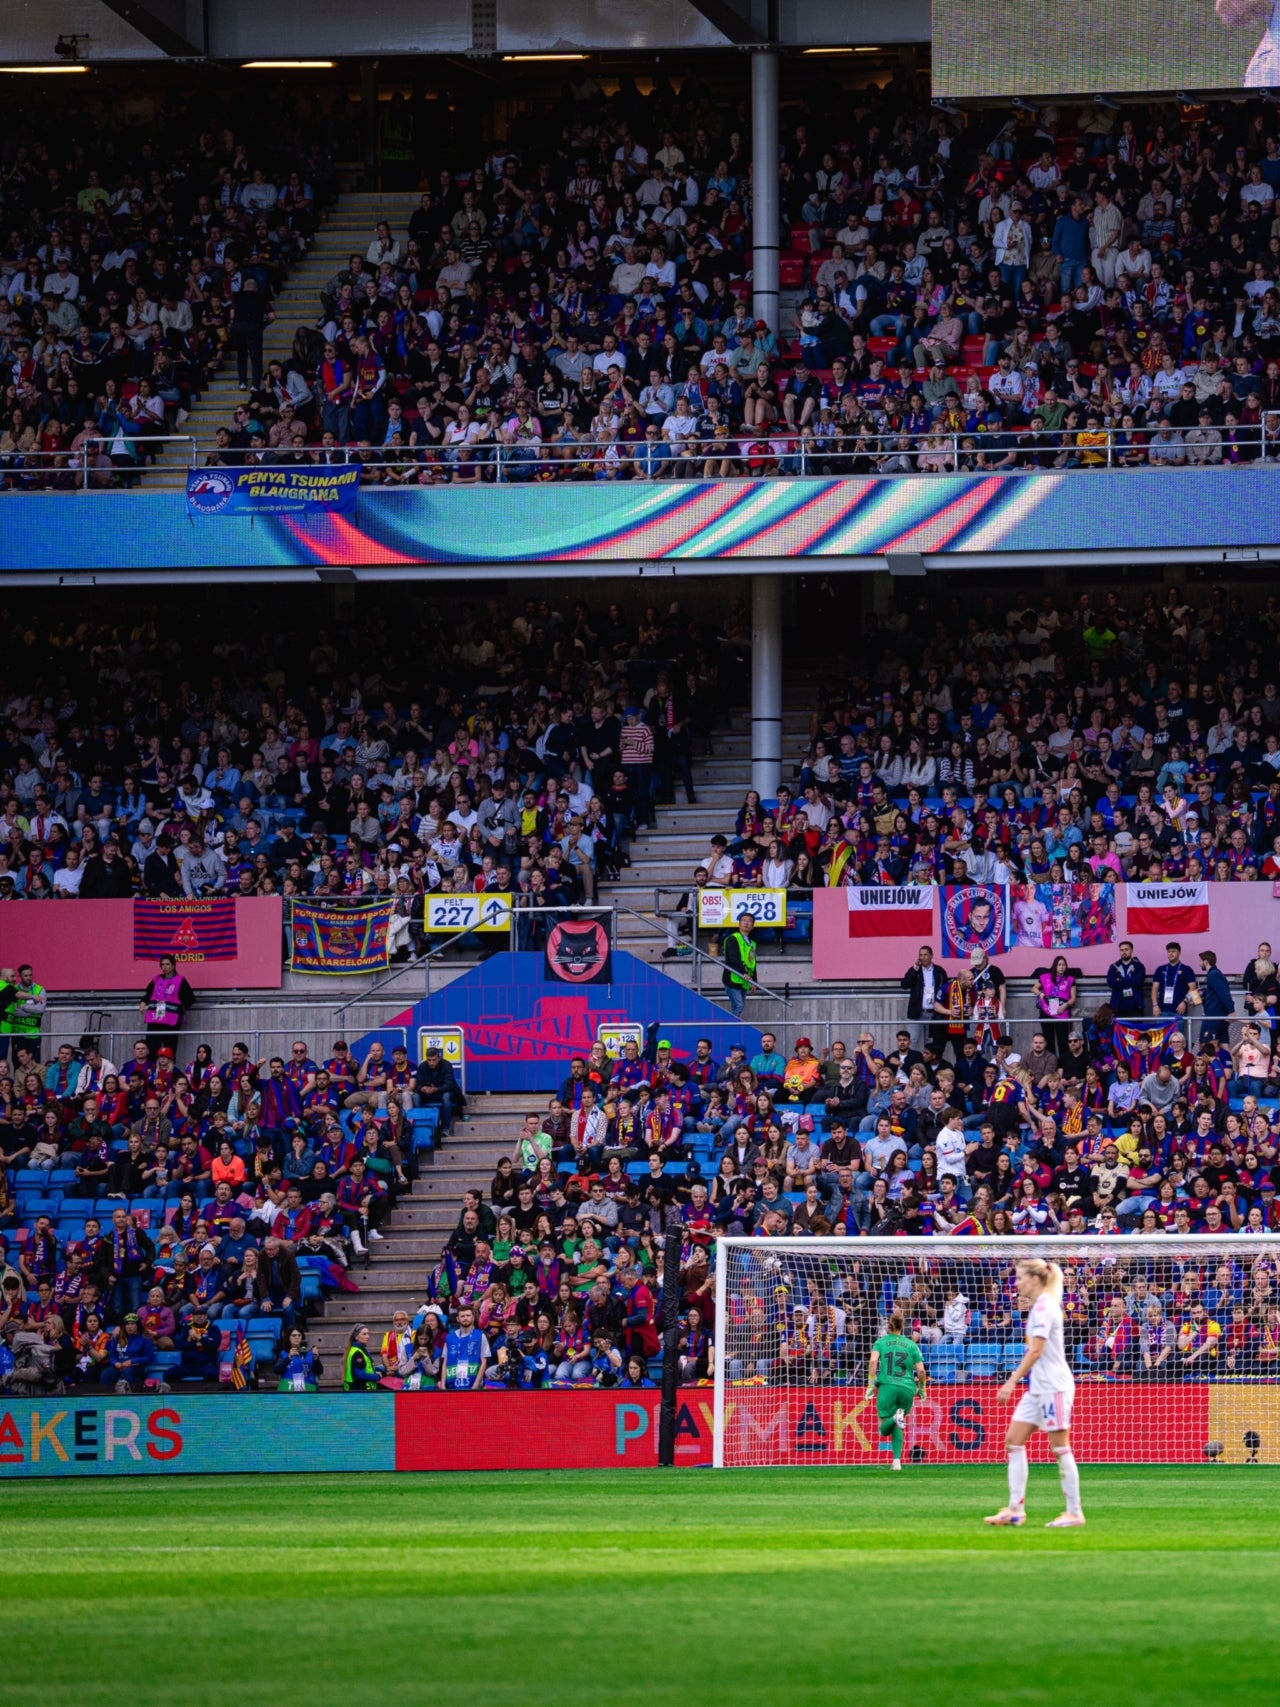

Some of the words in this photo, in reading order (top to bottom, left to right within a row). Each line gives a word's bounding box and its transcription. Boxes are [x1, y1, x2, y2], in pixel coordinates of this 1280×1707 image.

[237, 471, 287, 487] PENYA
[290, 470, 358, 487] TSUNAMI
[249, 486, 340, 502] BLAUGRANA
[444, 898, 465, 906] FELT
[702, 895, 722, 906] OBS!
[746, 893, 767, 901] FELT
[860, 887, 921, 905] UNIEJÓW
[1137, 888, 1197, 900] UNIEJÓW
[160, 905, 178, 913] LOS
[179, 904, 212, 913] AMIGOS
[434, 906, 474, 926] 227
[736, 901, 776, 921] 228
[347, 913, 359, 921] DE
[171, 953, 205, 962] ADRID
[884, 1351, 909, 1377] 13
[1042, 1402, 1055, 1418] 14
[615, 1398, 985, 1456] PLAYMAKRS
